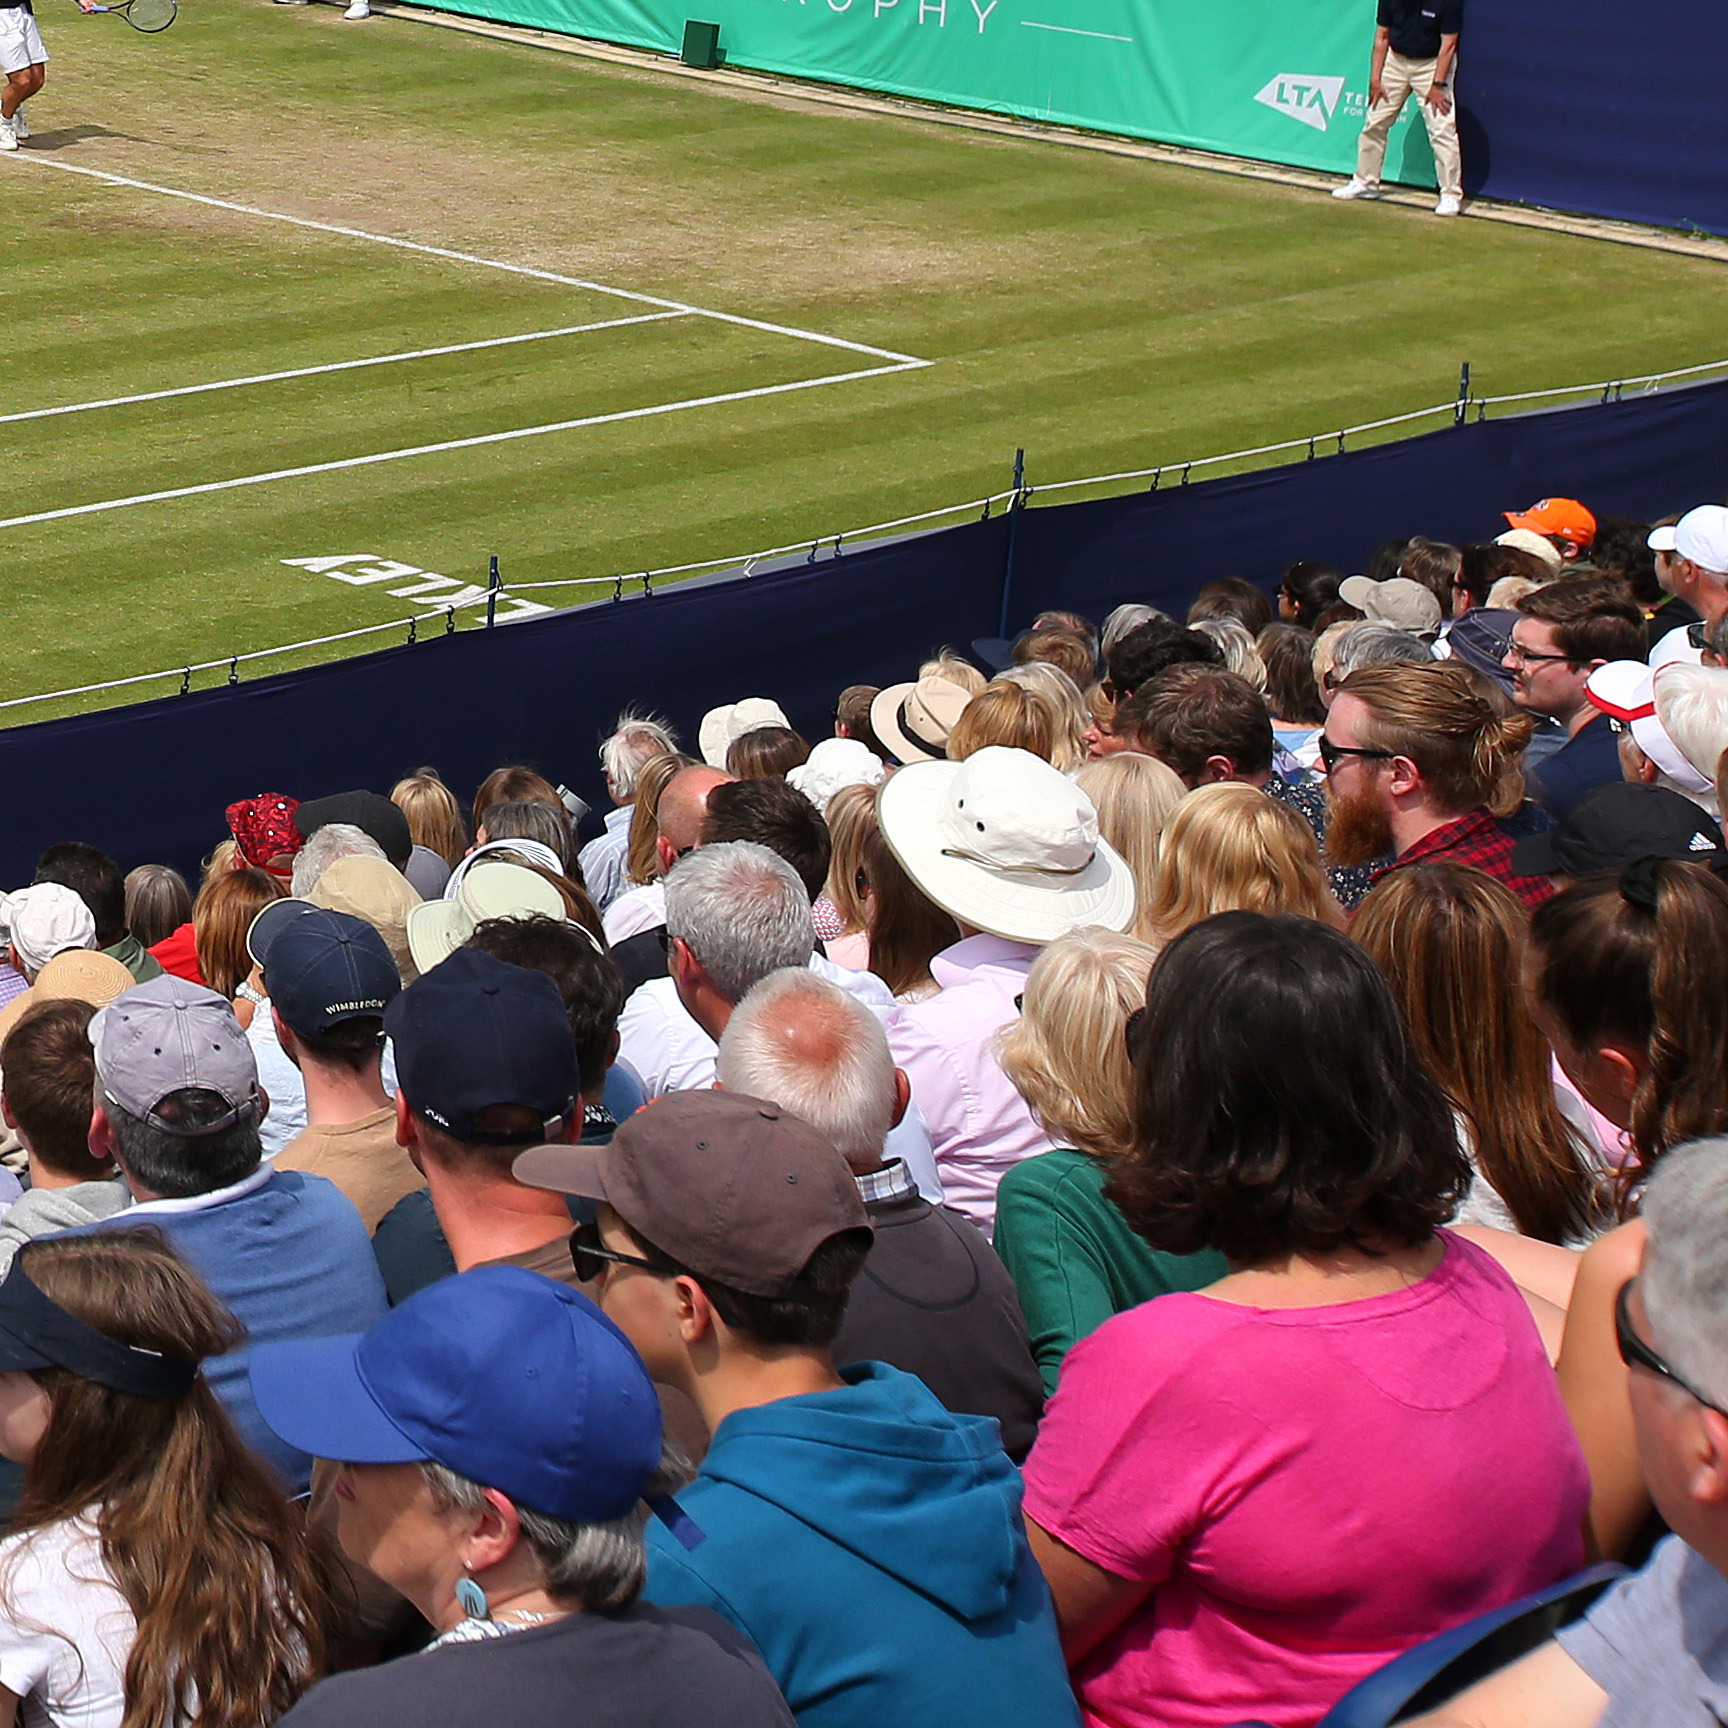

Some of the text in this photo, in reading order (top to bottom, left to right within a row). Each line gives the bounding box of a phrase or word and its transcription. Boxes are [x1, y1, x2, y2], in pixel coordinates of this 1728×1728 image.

[1276, 82, 1326, 109] LTA
[1343, 106, 1365, 116] FOR
[279, 554, 556, 624] LKLEY
[325, 998, 386, 1015] WIMBLEDON
